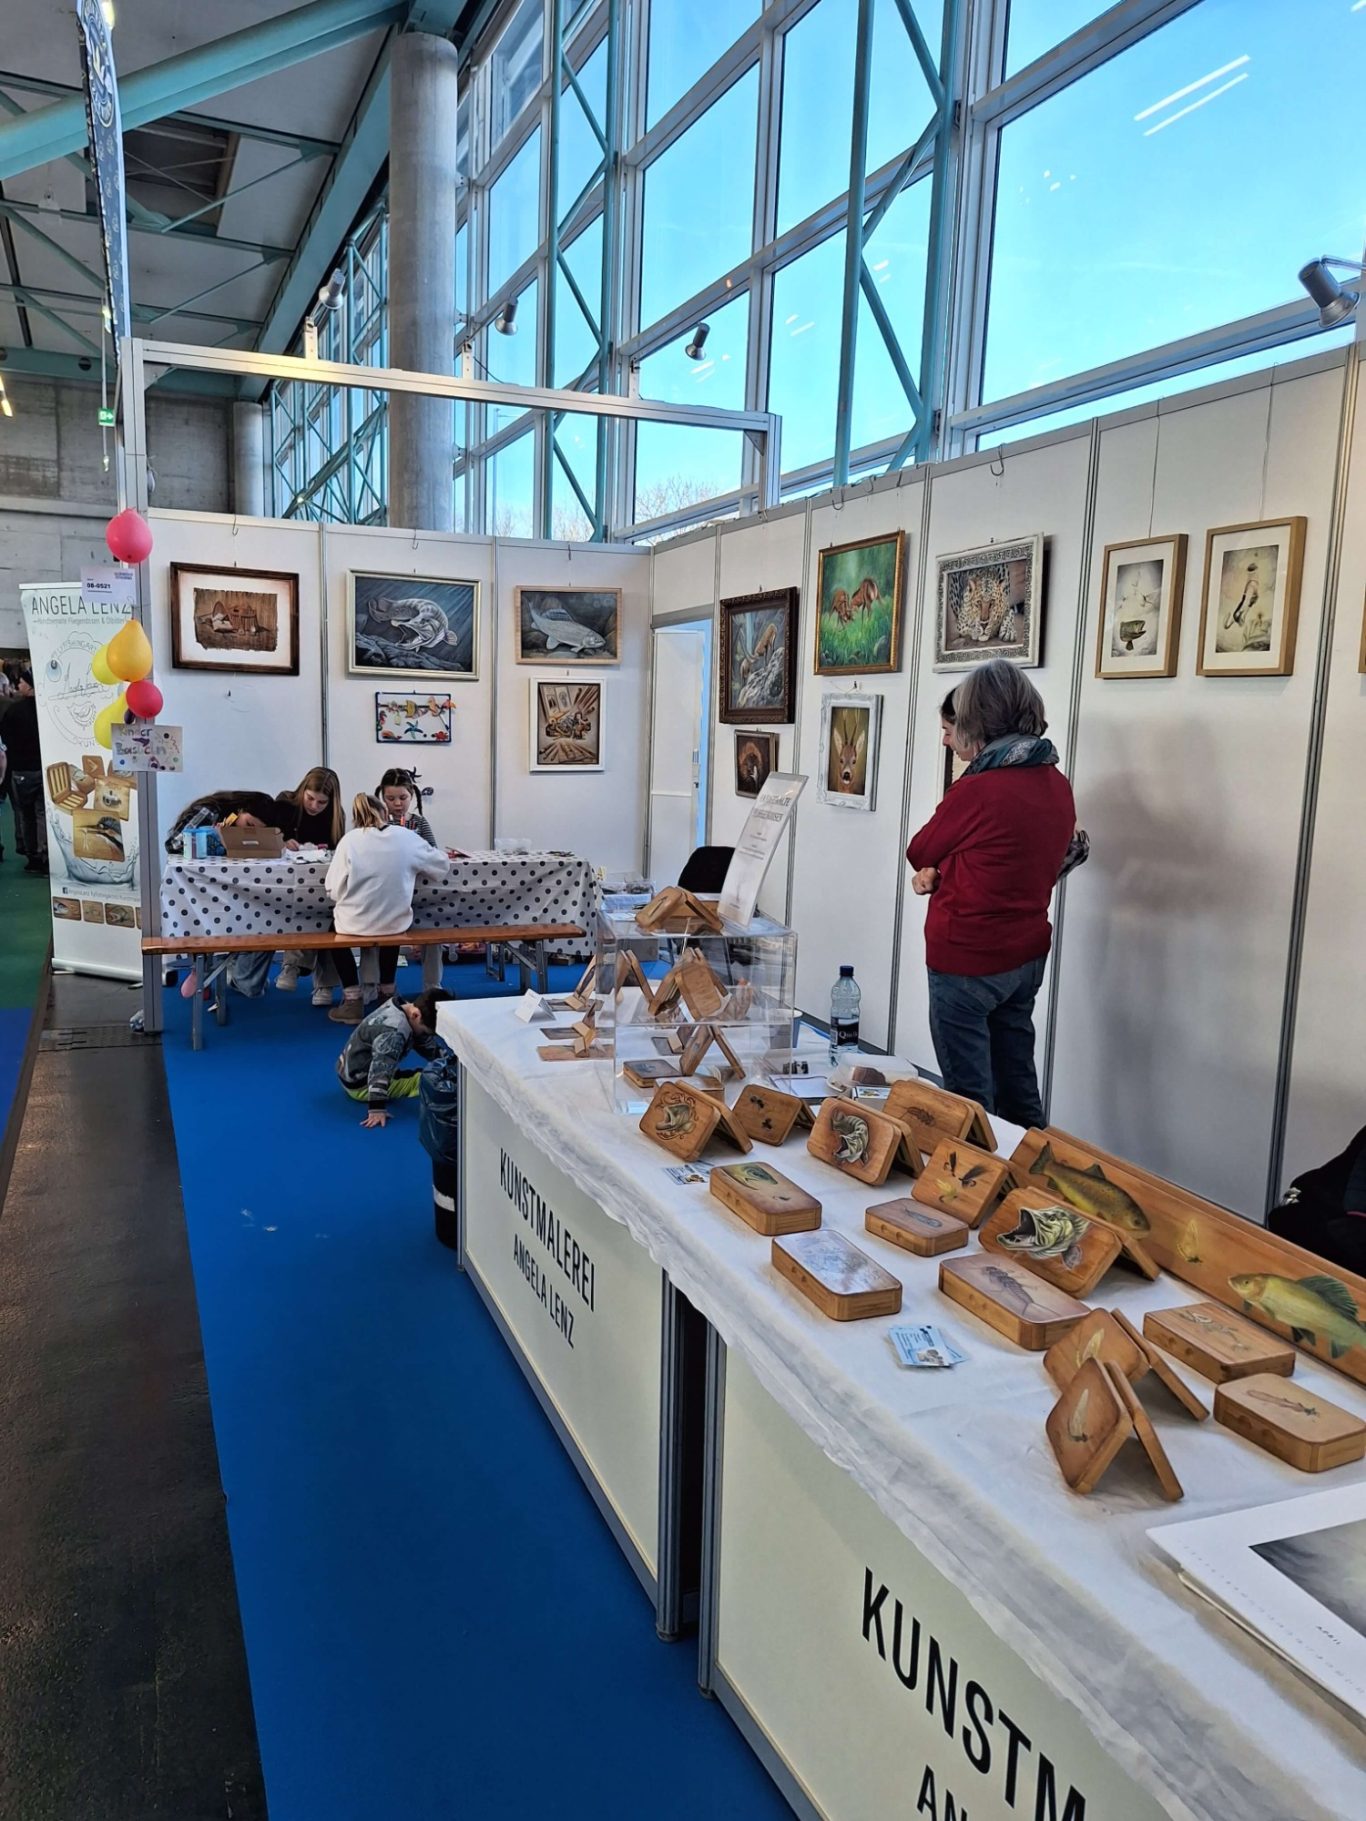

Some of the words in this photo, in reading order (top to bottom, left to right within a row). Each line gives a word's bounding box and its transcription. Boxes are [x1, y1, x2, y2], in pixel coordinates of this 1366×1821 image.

[32, 595, 87, 615] ANGELA
[500, 1147, 595, 1313] KUNSTMALEREI
[513, 1233, 547, 1309] ANGELA
[549, 1284, 575, 1350] LENZ
